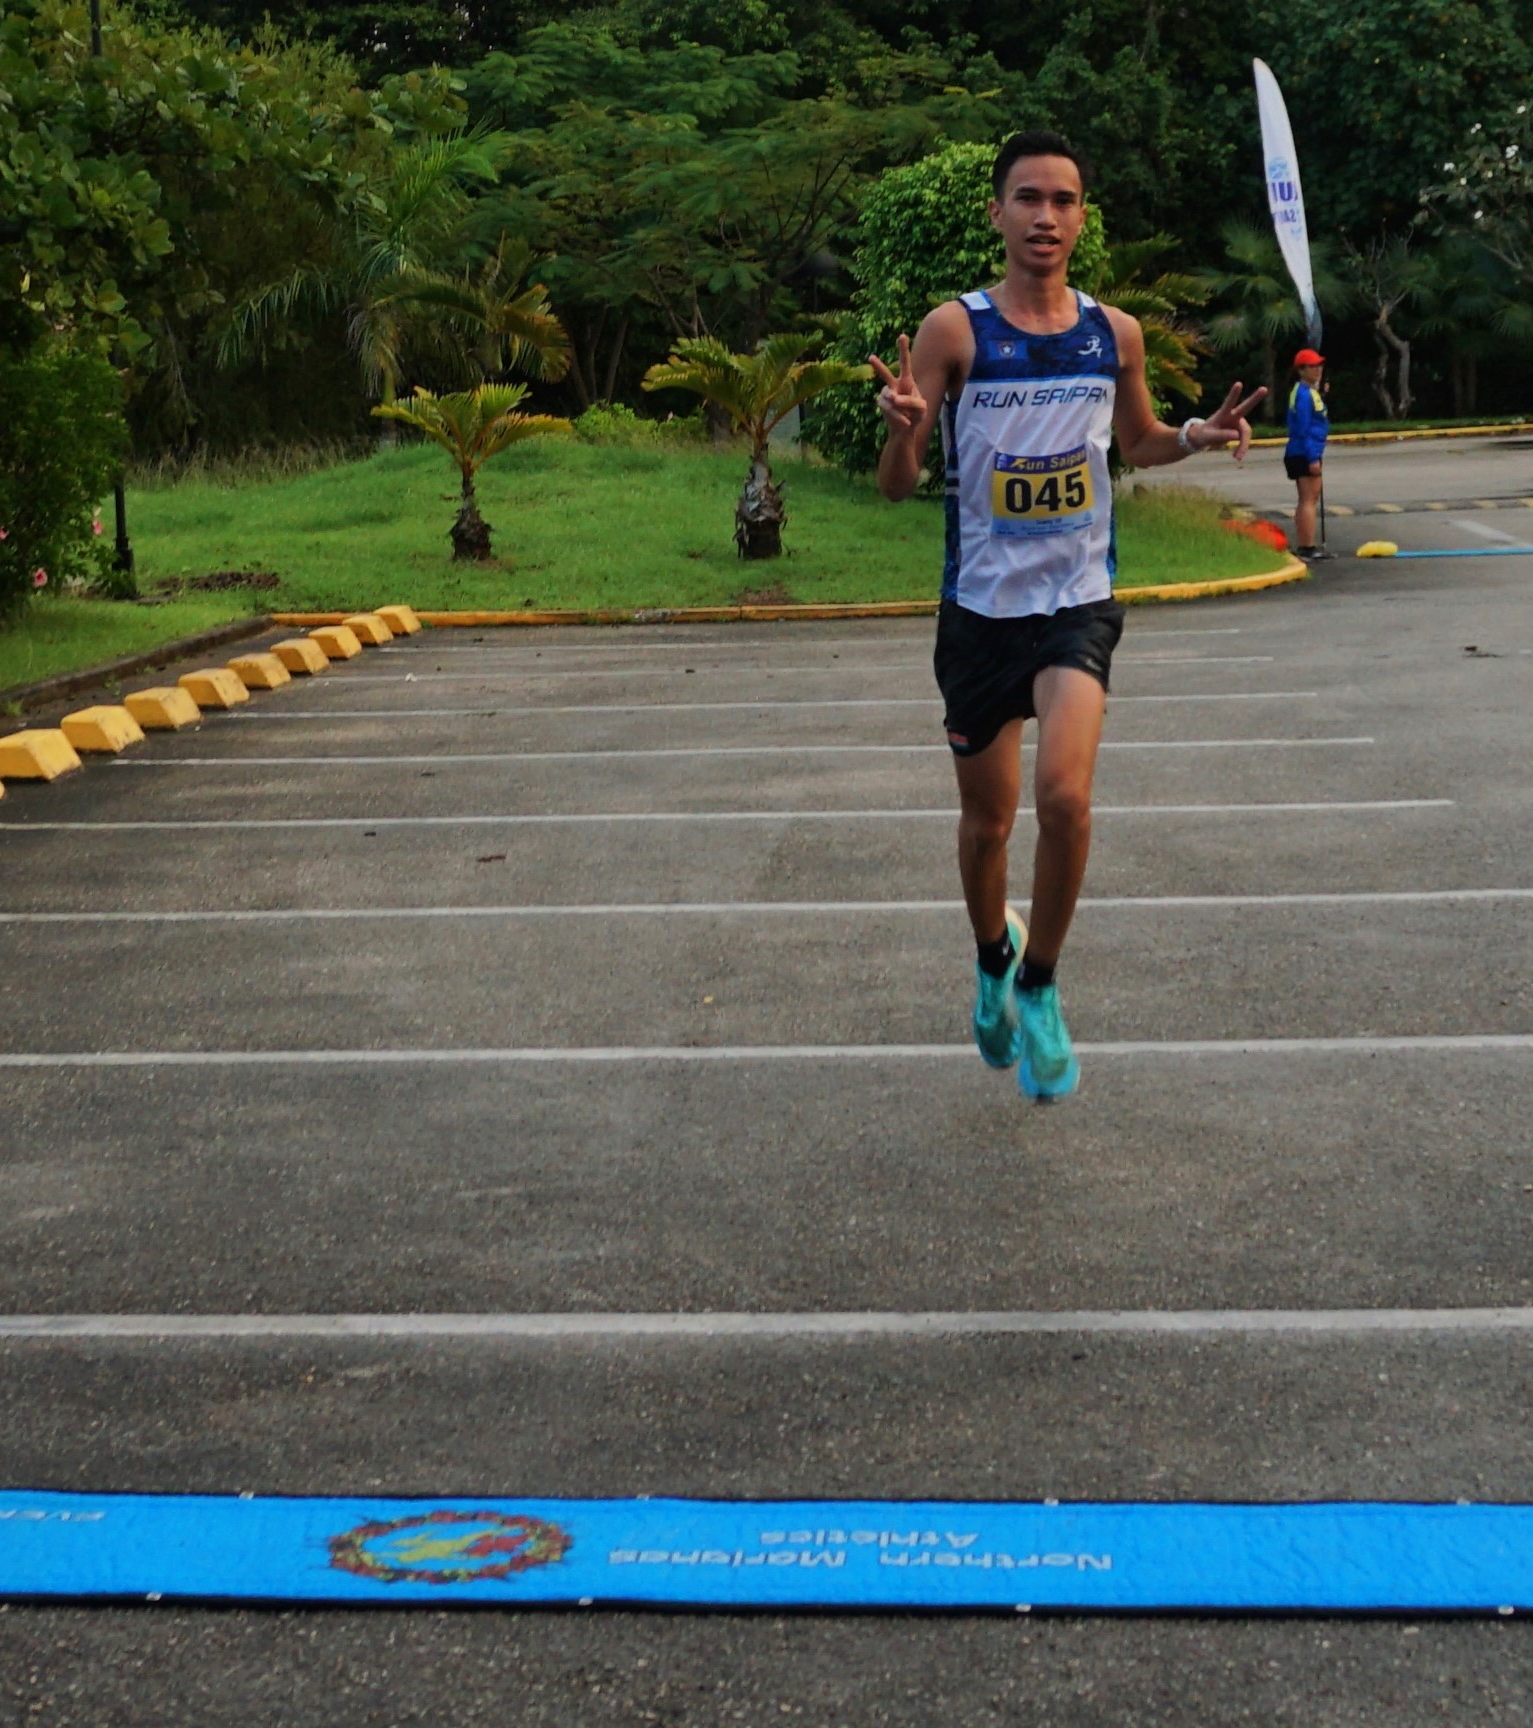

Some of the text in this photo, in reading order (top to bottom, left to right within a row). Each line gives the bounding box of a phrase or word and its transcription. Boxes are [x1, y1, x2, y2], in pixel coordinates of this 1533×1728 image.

[972, 390, 1028, 409] RUN
[1005, 470, 1086, 514] 045
[760, 1529, 979, 1550] Athletics
[608, 1548, 1113, 1570] Northern Marianas
